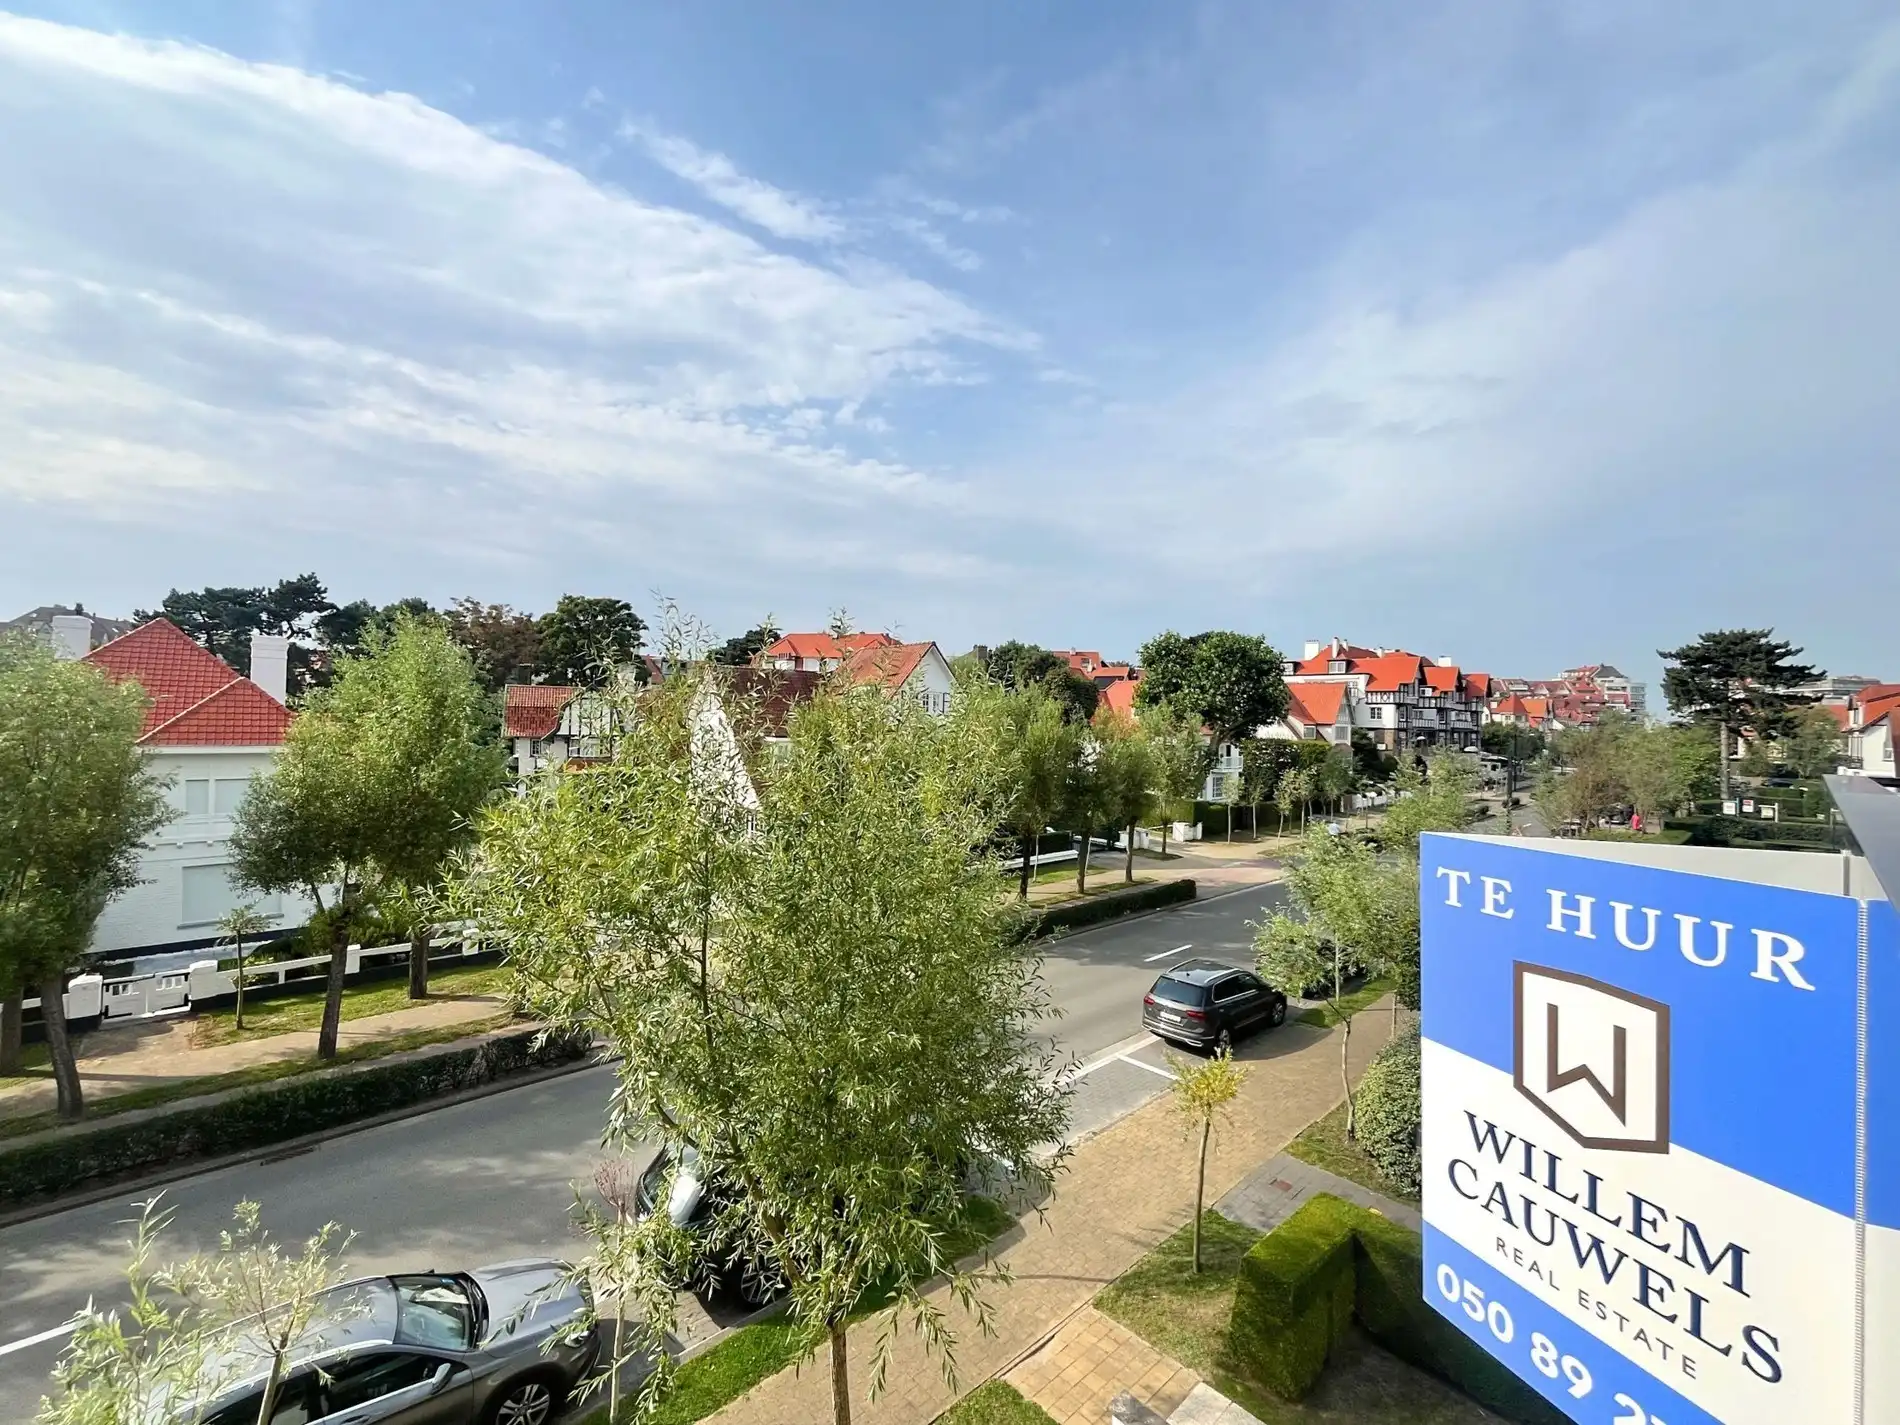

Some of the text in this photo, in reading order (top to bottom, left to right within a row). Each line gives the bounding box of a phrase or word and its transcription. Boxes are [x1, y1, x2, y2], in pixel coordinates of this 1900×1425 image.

[1436, 866, 1816, 991] TE HUUR
[1448, 1158, 1782, 1383] CAUWELS
[1464, 1110, 1750, 1298] WILLEM
[1436, 1263, 1668, 1425] 050 89 2
[1496, 1236, 1697, 1380] REAL ESTATE
